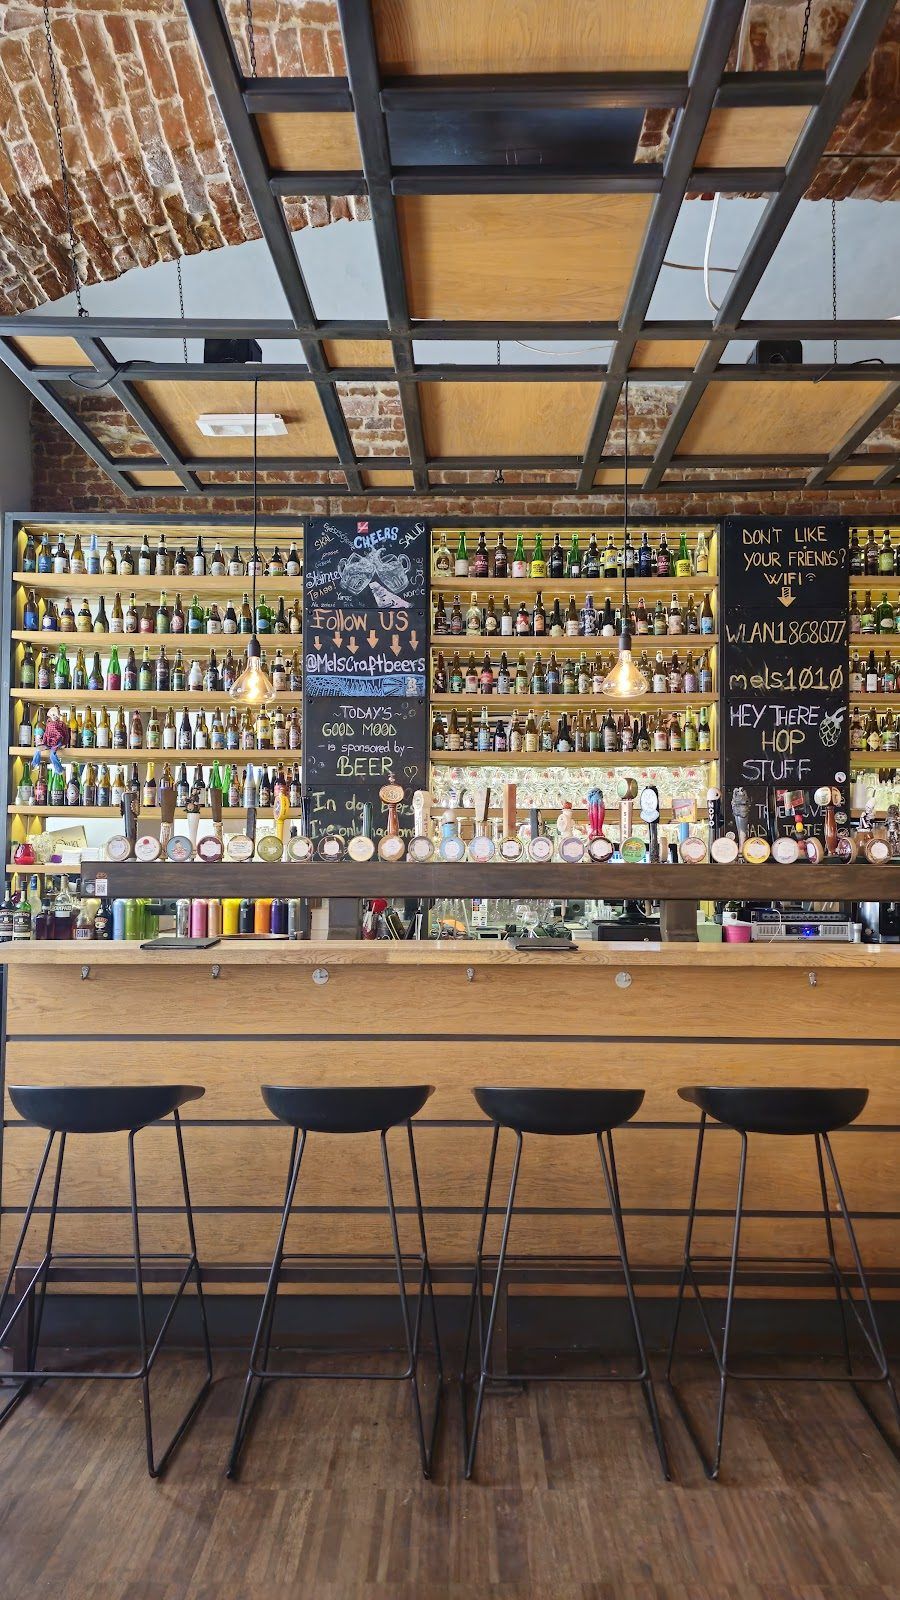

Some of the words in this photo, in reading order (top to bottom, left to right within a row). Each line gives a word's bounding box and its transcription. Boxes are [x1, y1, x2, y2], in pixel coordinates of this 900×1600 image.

[353, 526, 399, 549] CHEERS
[742, 526, 783, 545] DON'T
[794, 525, 828, 543] LIKE
[743, 551, 782, 572] YOUR
[763, 572, 802, 586] WIFI
[310, 608, 368, 632] Follow
[377, 610, 409, 632] US
[305, 652, 426, 676] @MelsCraftbeers
[339, 705, 393, 720] TODAY'S
[730, 704, 767, 728] HEY
[769, 704, 821, 727] THERE
[322, 722, 355, 737] GOOD
[362, 722, 398, 737] MOOD
[327, 741, 336, 751] is
[341, 741, 390, 756] sponsored
[393, 740, 406, 757] by
[761, 729, 806, 754] HOP
[336, 755, 394, 777] BEER
[741, 758, 812, 782] STUFF
[312, 791, 337, 812] In
[345, 793, 364, 819] do
[381, 800, 415, 816] bers
[755, 803, 787, 819] TRE
[309, 820, 334, 839] I've
